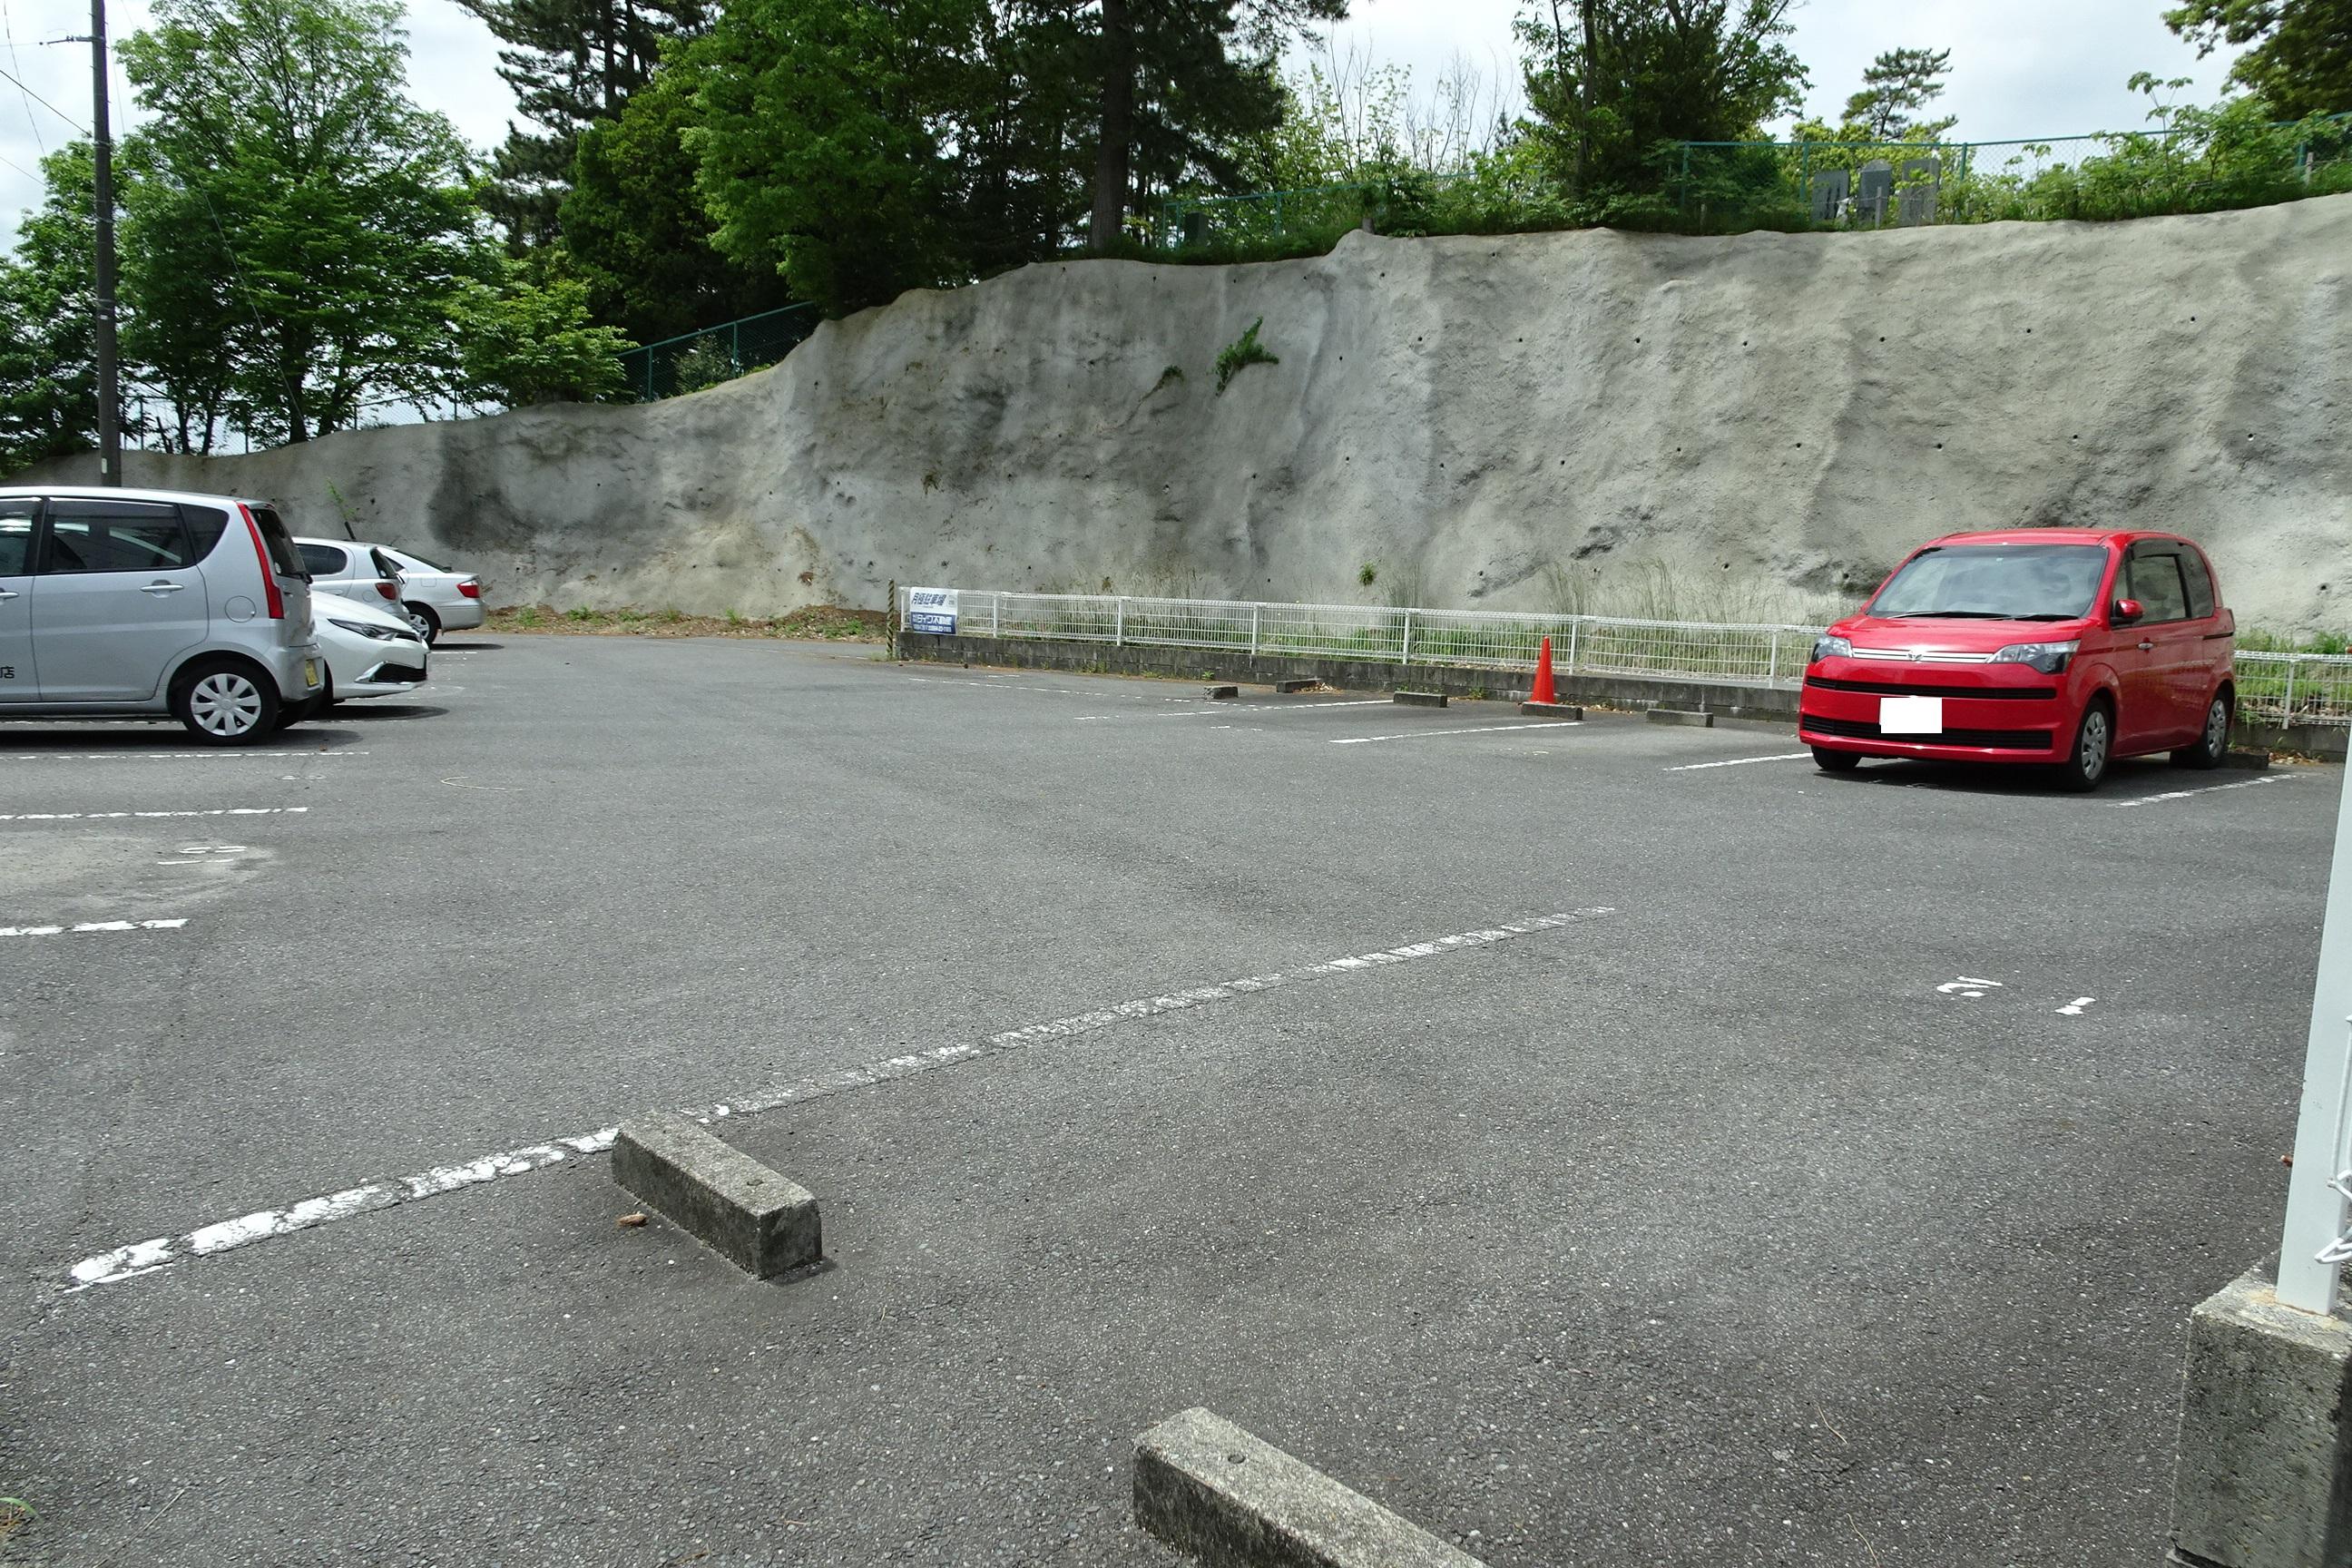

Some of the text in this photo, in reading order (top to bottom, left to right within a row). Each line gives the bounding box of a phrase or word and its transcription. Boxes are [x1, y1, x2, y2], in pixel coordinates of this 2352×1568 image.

[911, 593, 946, 606] 月極駐車場
